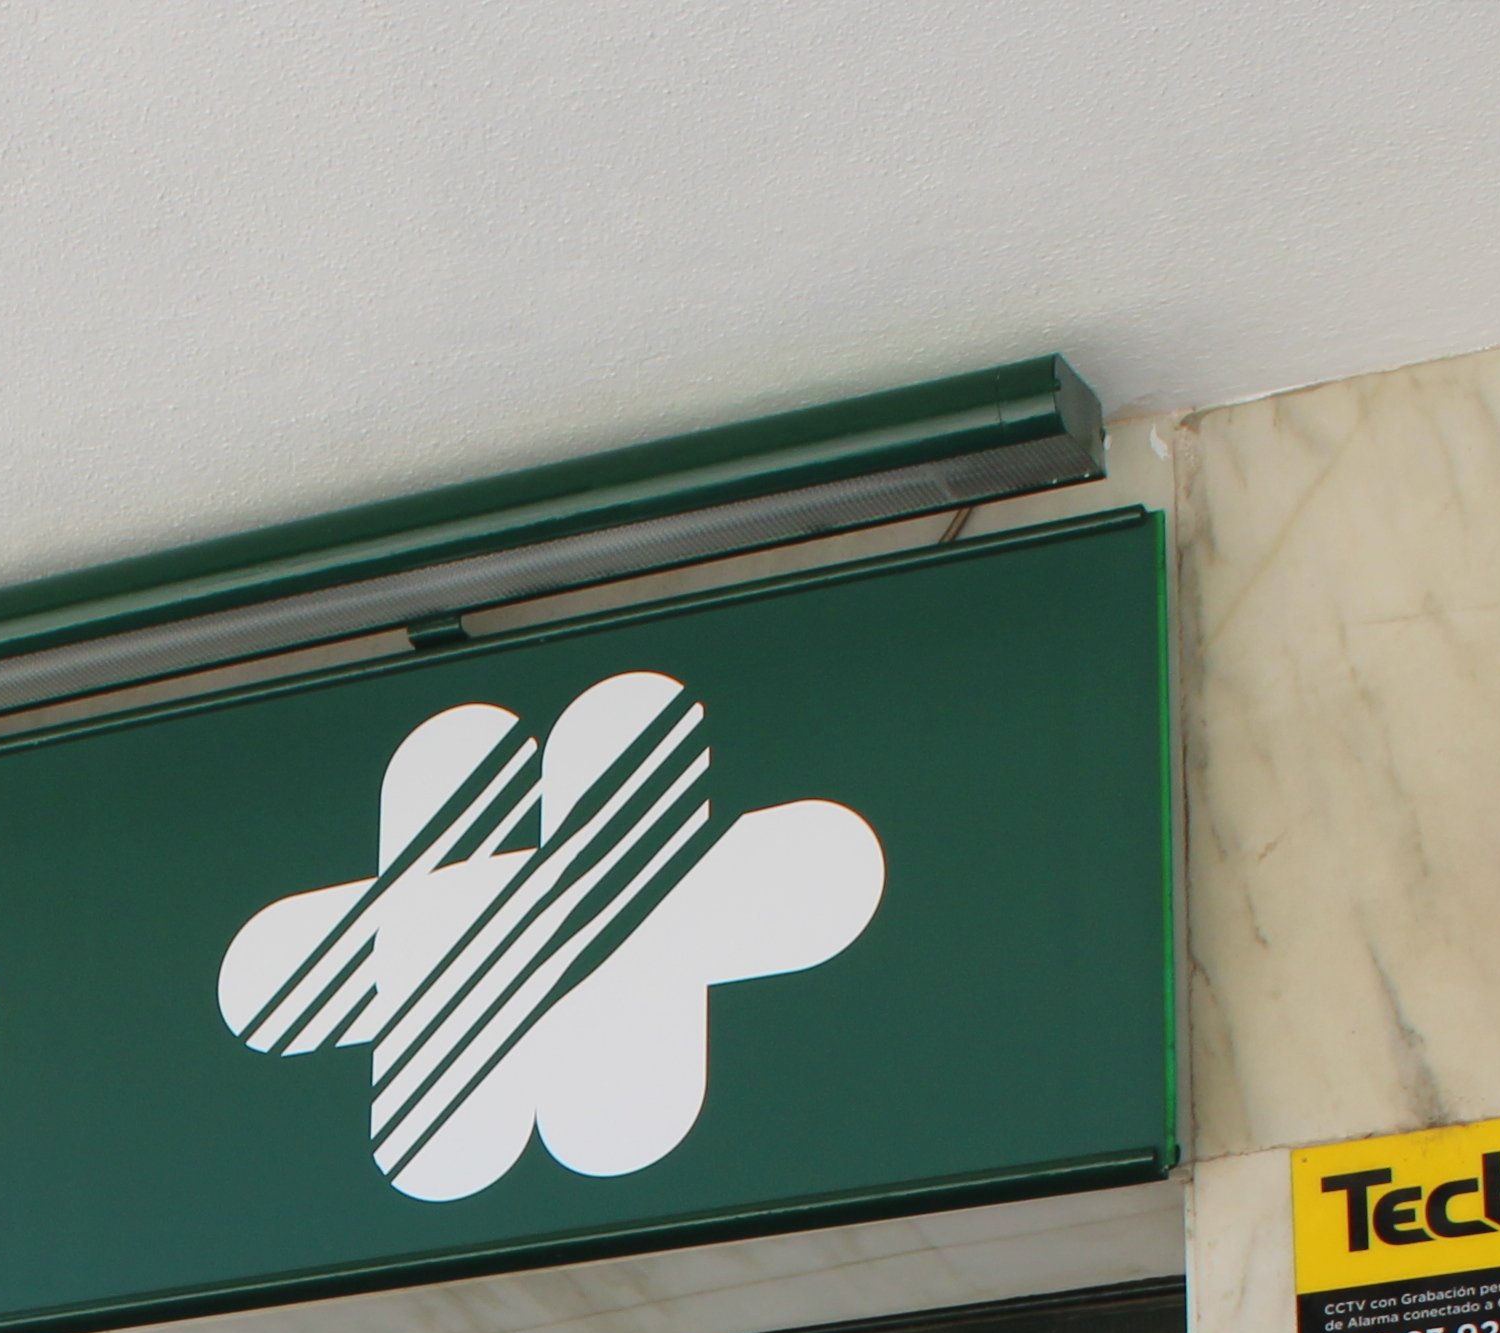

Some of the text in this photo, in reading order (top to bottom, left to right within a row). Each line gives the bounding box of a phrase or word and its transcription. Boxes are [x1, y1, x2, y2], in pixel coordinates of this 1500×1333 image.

[1324, 1300, 1366, 1315] CCTV
[1370, 1297, 1397, 1309] con
[1400, 1284, 1475, 1305] Grabación
[1325, 1320, 1343, 1332] de
[1347, 1313, 1399, 1329] Alarma
[1403, 1301, 1480, 1321] conectado
[1484, 1301, 1493, 1310] a
